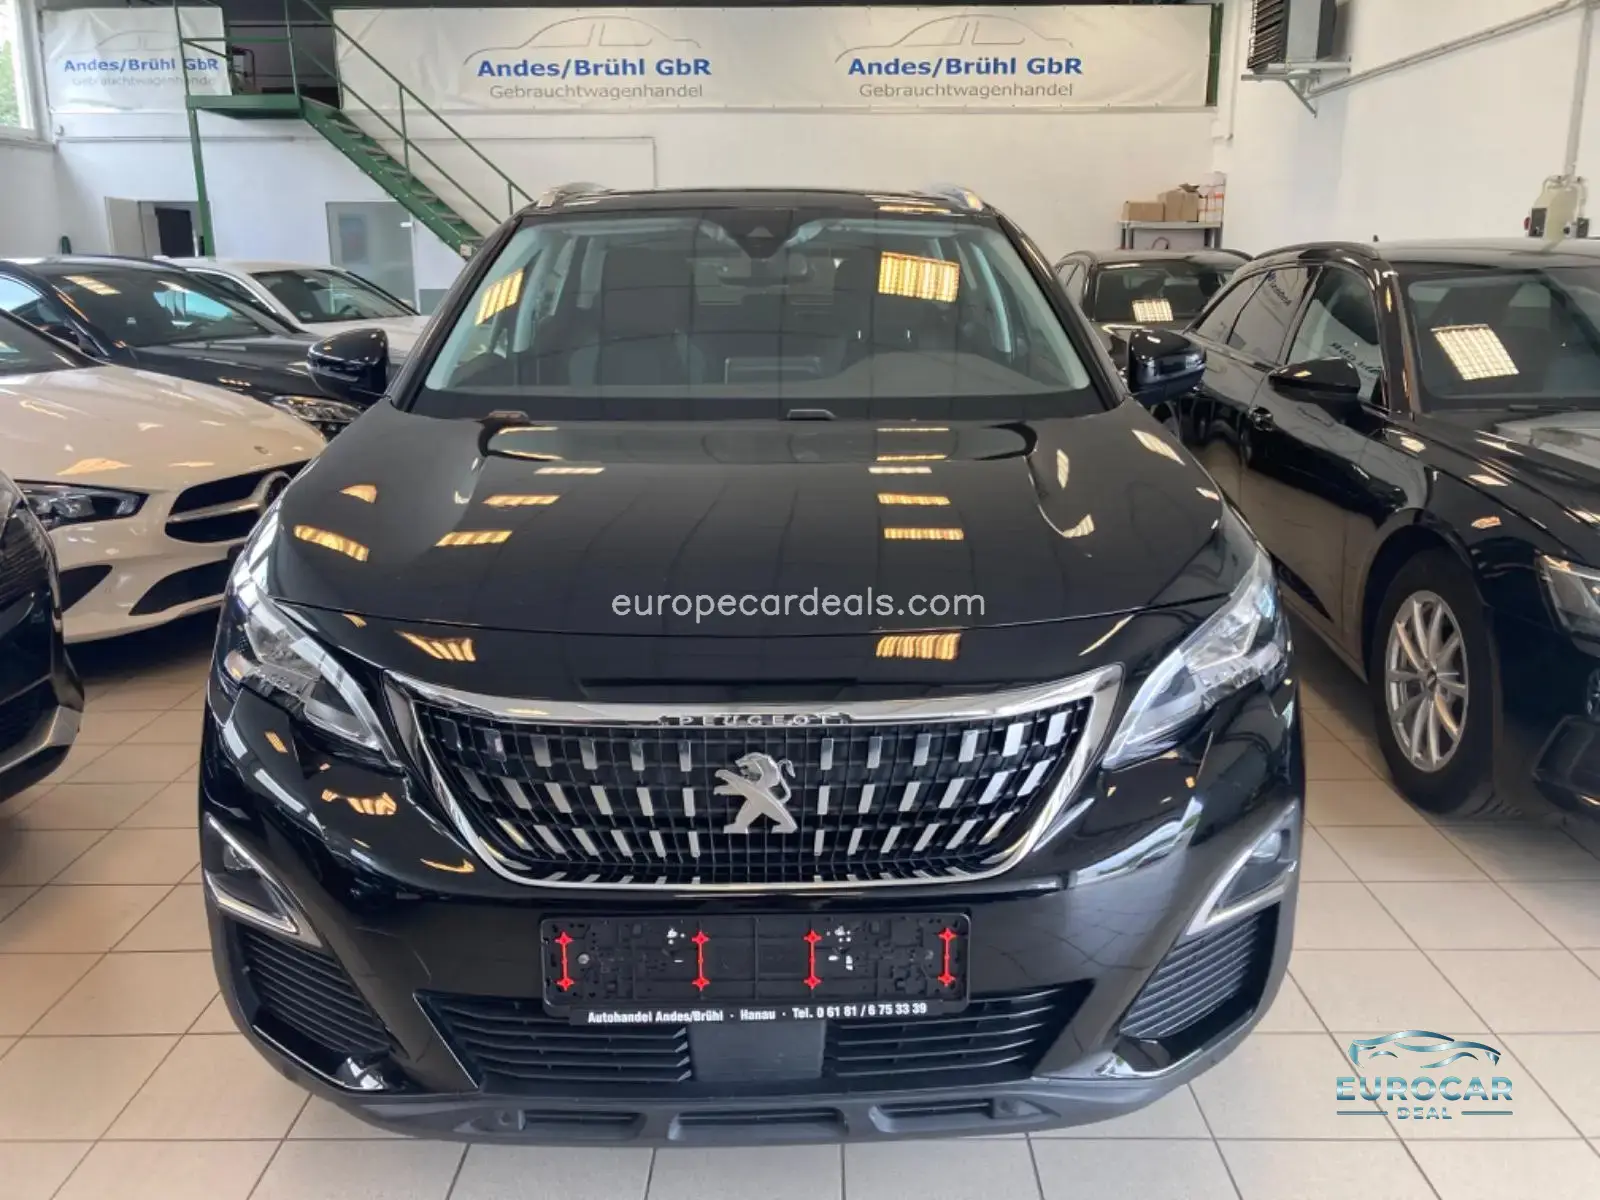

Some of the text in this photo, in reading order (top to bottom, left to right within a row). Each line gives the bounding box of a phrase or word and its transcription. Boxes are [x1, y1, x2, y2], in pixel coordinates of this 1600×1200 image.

[64, 58, 219, 72] Andes/Brühl GbR
[477, 58, 712, 79] Andes/Brühl GbR
[848, 57, 1083, 78] Andes/Brühl GbR
[490, 84, 703, 100] Gebrauchtwagenhandel
[859, 83, 1073, 99] Gebrauchtwagenhandel
[679, 713, 836, 726] PEUGEOT
[587, 1011, 653, 1023] Autohandel
[655, 1009, 724, 1023] Andes/Brühl
[740, 1008, 776, 1021] Hanau
[791, 1007, 814, 1019] Tel.
